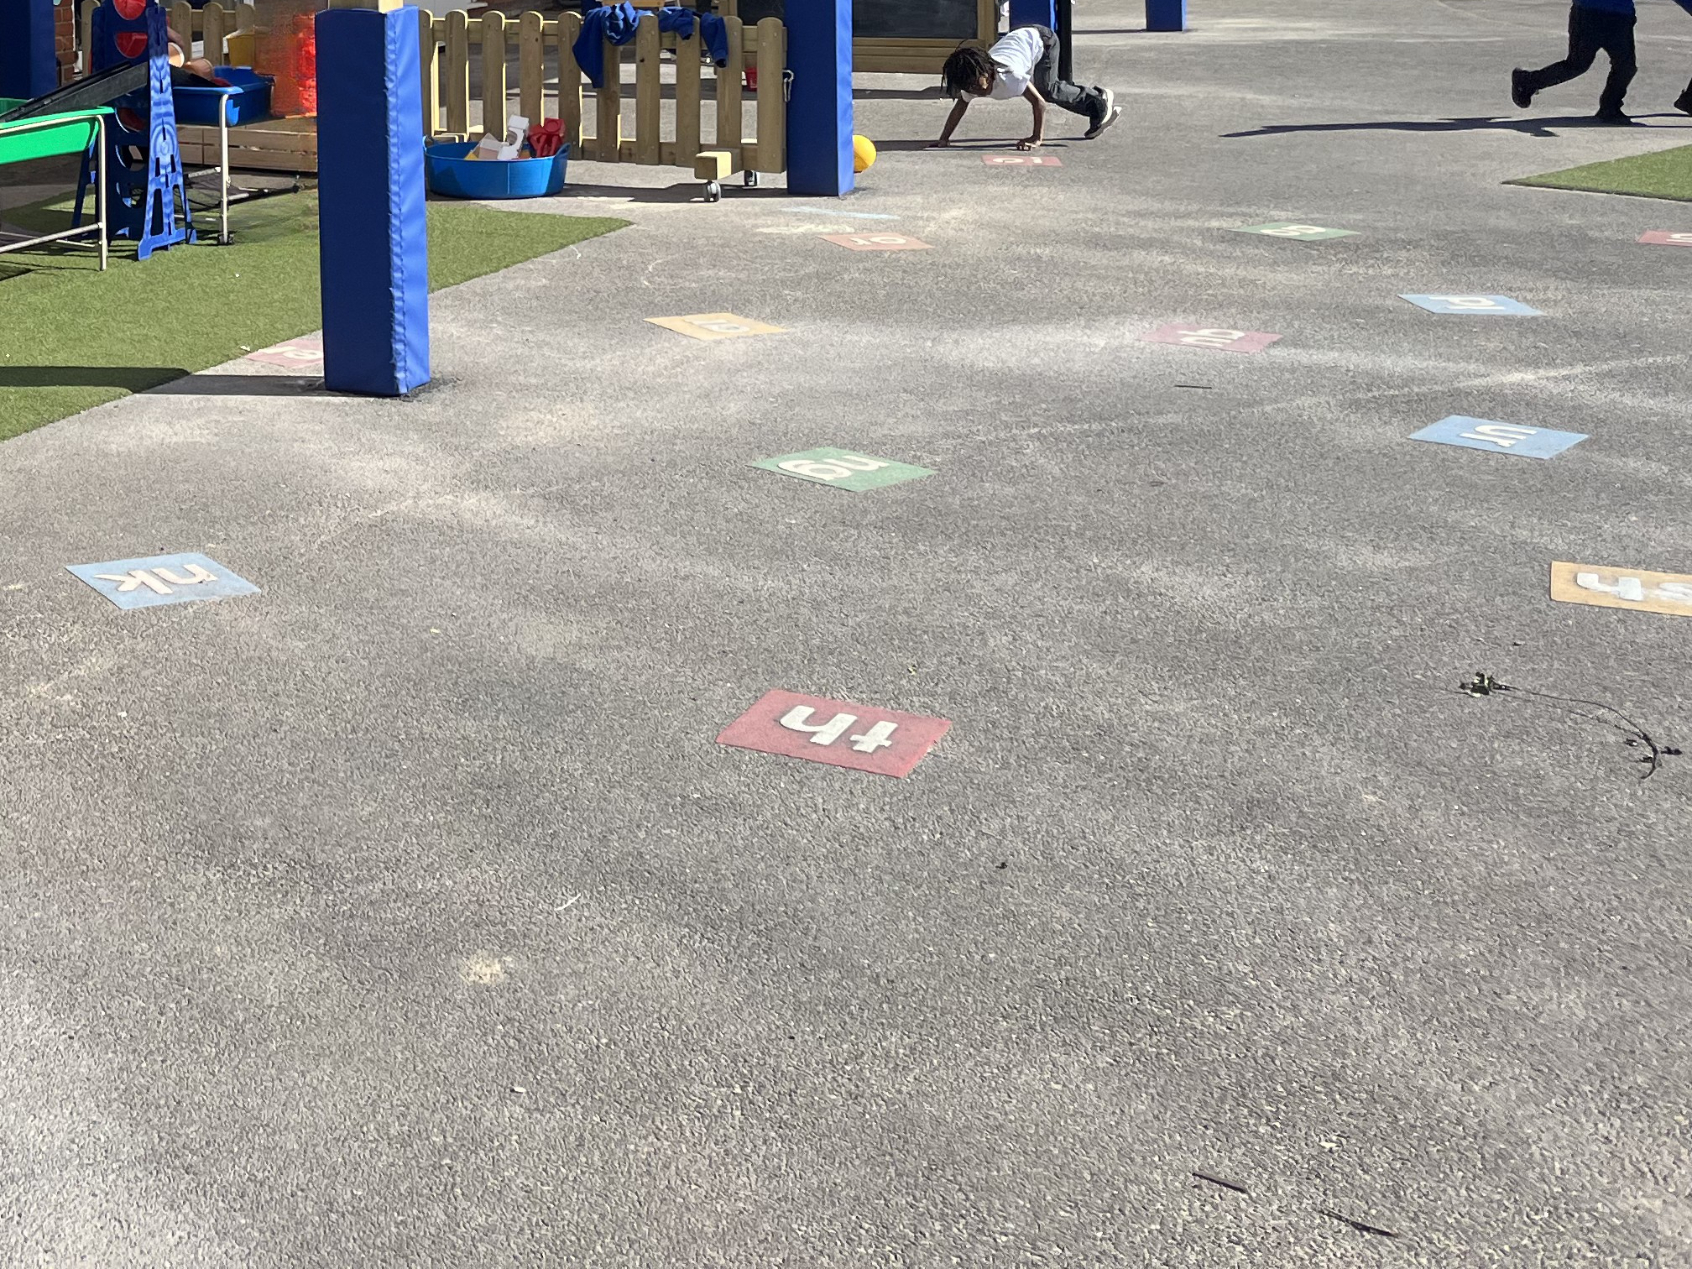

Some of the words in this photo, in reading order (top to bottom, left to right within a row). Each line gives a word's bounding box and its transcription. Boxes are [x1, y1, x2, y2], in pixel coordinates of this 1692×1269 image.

[1459, 423, 1537, 448] ur
[778, 455, 889, 482] ng
[93, 562, 219, 595] nk
[779, 704, 899, 754] th
